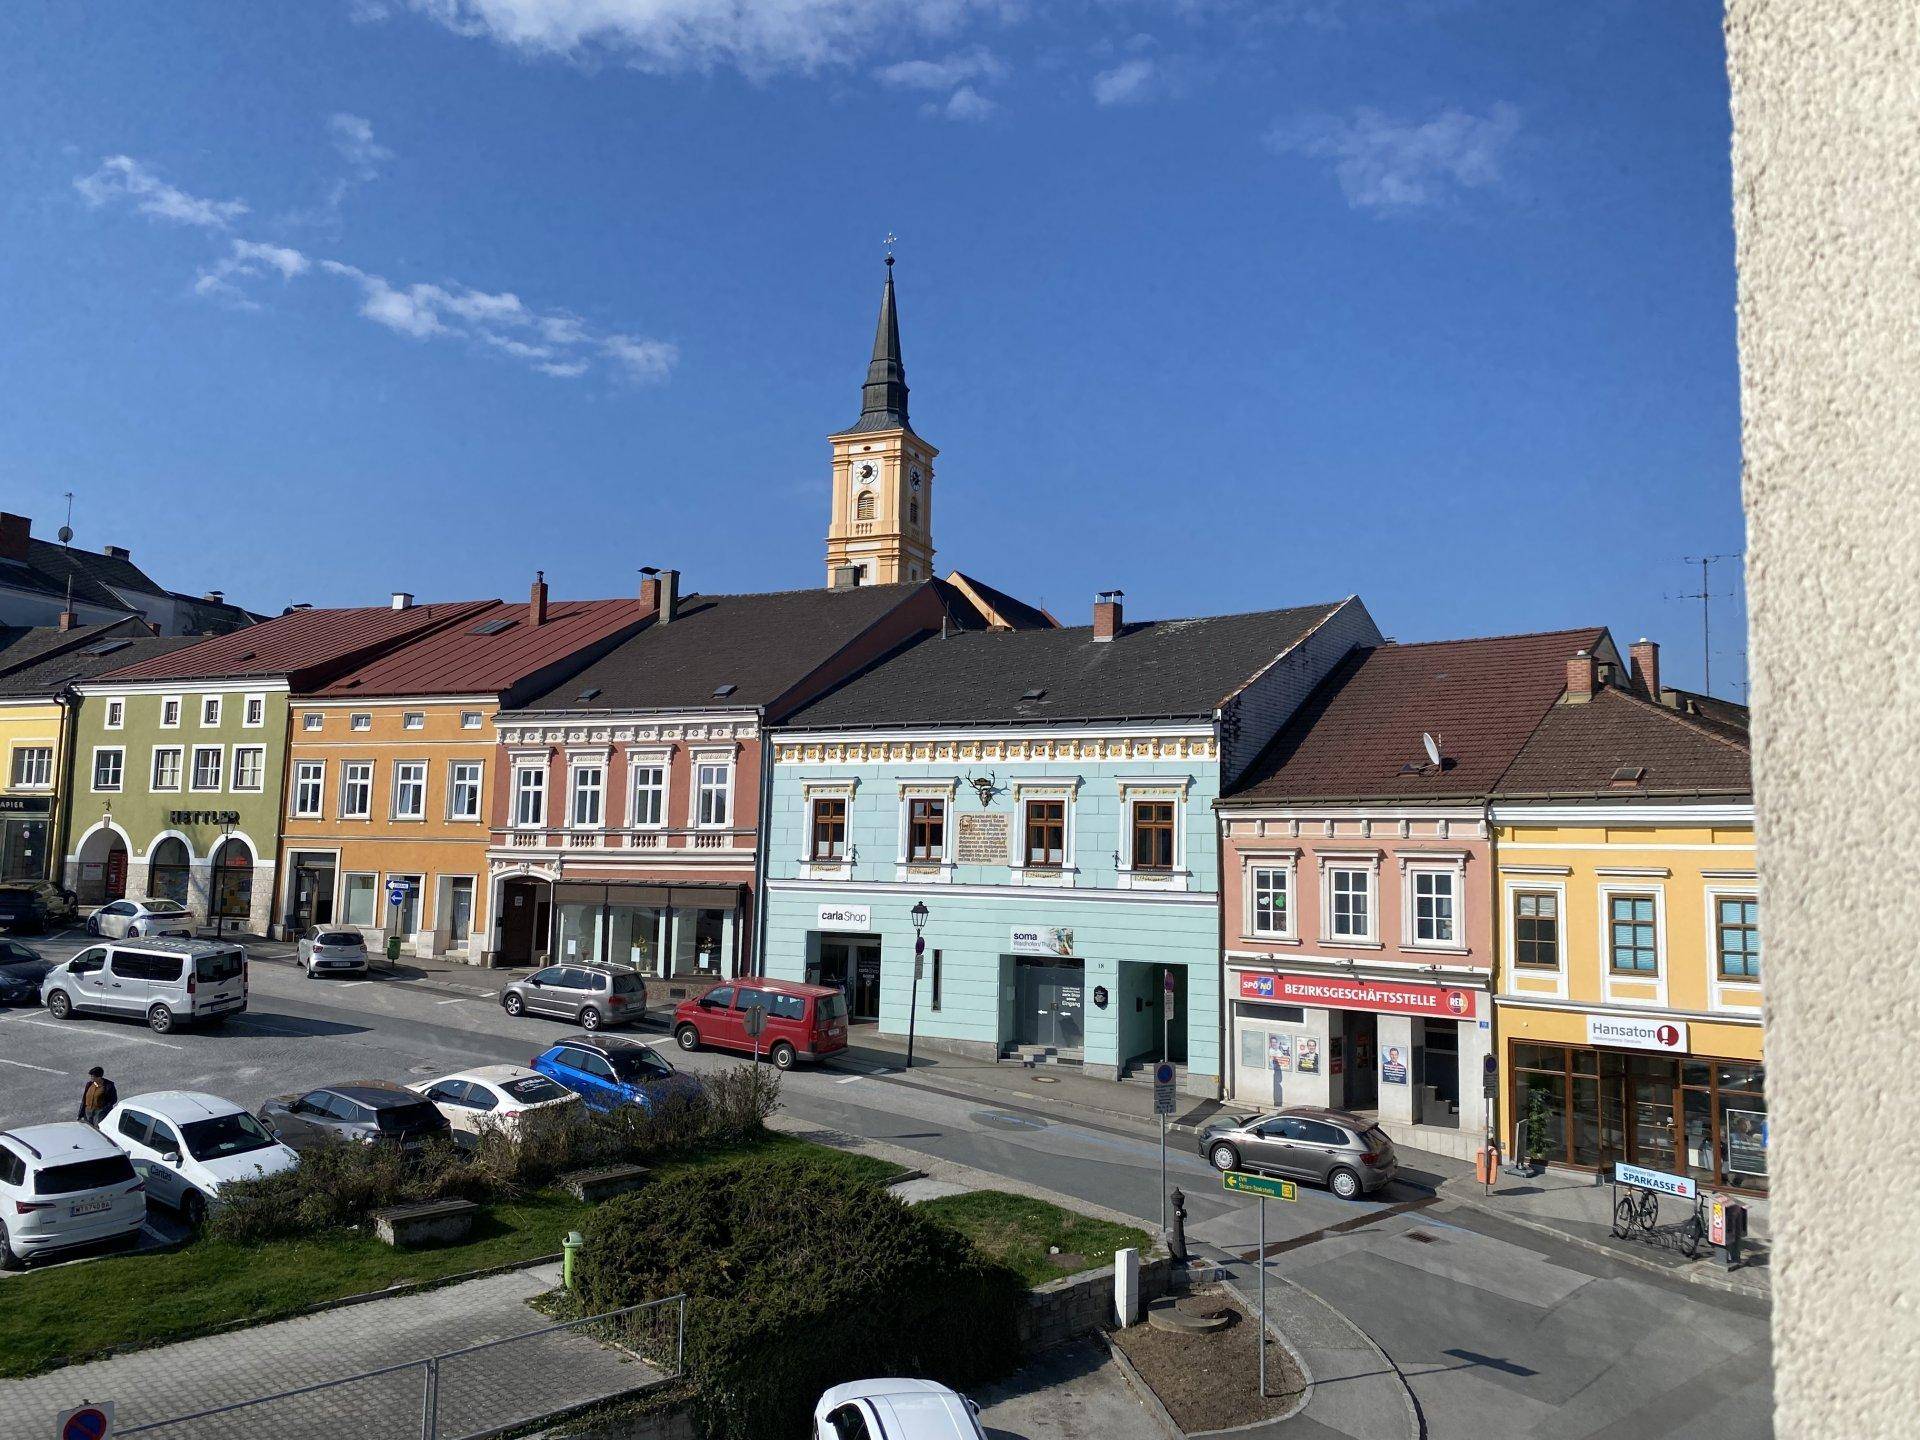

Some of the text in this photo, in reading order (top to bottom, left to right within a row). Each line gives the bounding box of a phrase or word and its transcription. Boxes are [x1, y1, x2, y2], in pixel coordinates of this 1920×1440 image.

[1013, 932, 1038, 941] soma
[1284, 983, 1437, 1007] BEZIRKSGESCHÄFTSSTELLE
[1592, 1022, 1656, 1039] Hansaton
[1623, 1172, 1676, 1192] SPARKASSE
